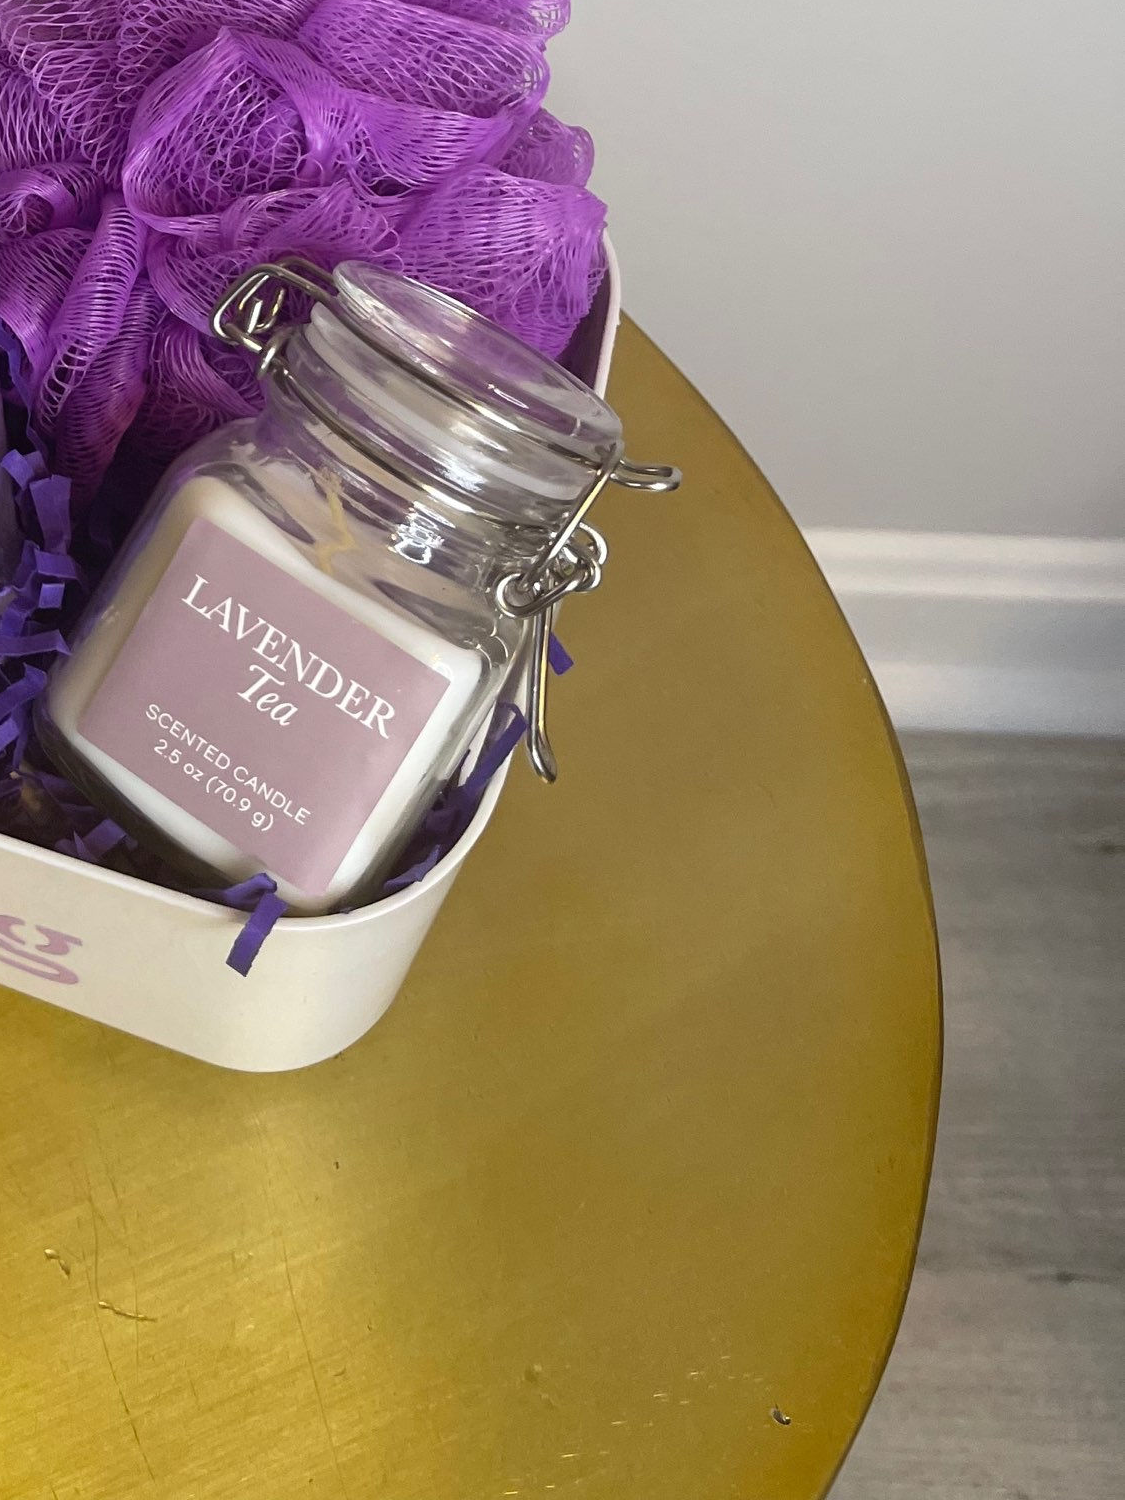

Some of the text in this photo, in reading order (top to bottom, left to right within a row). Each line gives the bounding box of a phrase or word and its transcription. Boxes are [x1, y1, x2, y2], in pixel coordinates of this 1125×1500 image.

[181, 574, 396, 739] LAVENDER
[237, 664, 299, 727] Tea
[145, 703, 311, 825] SCENTED CANDLE
[153, 738, 275, 833] 2.5 oz (70.9 g)
